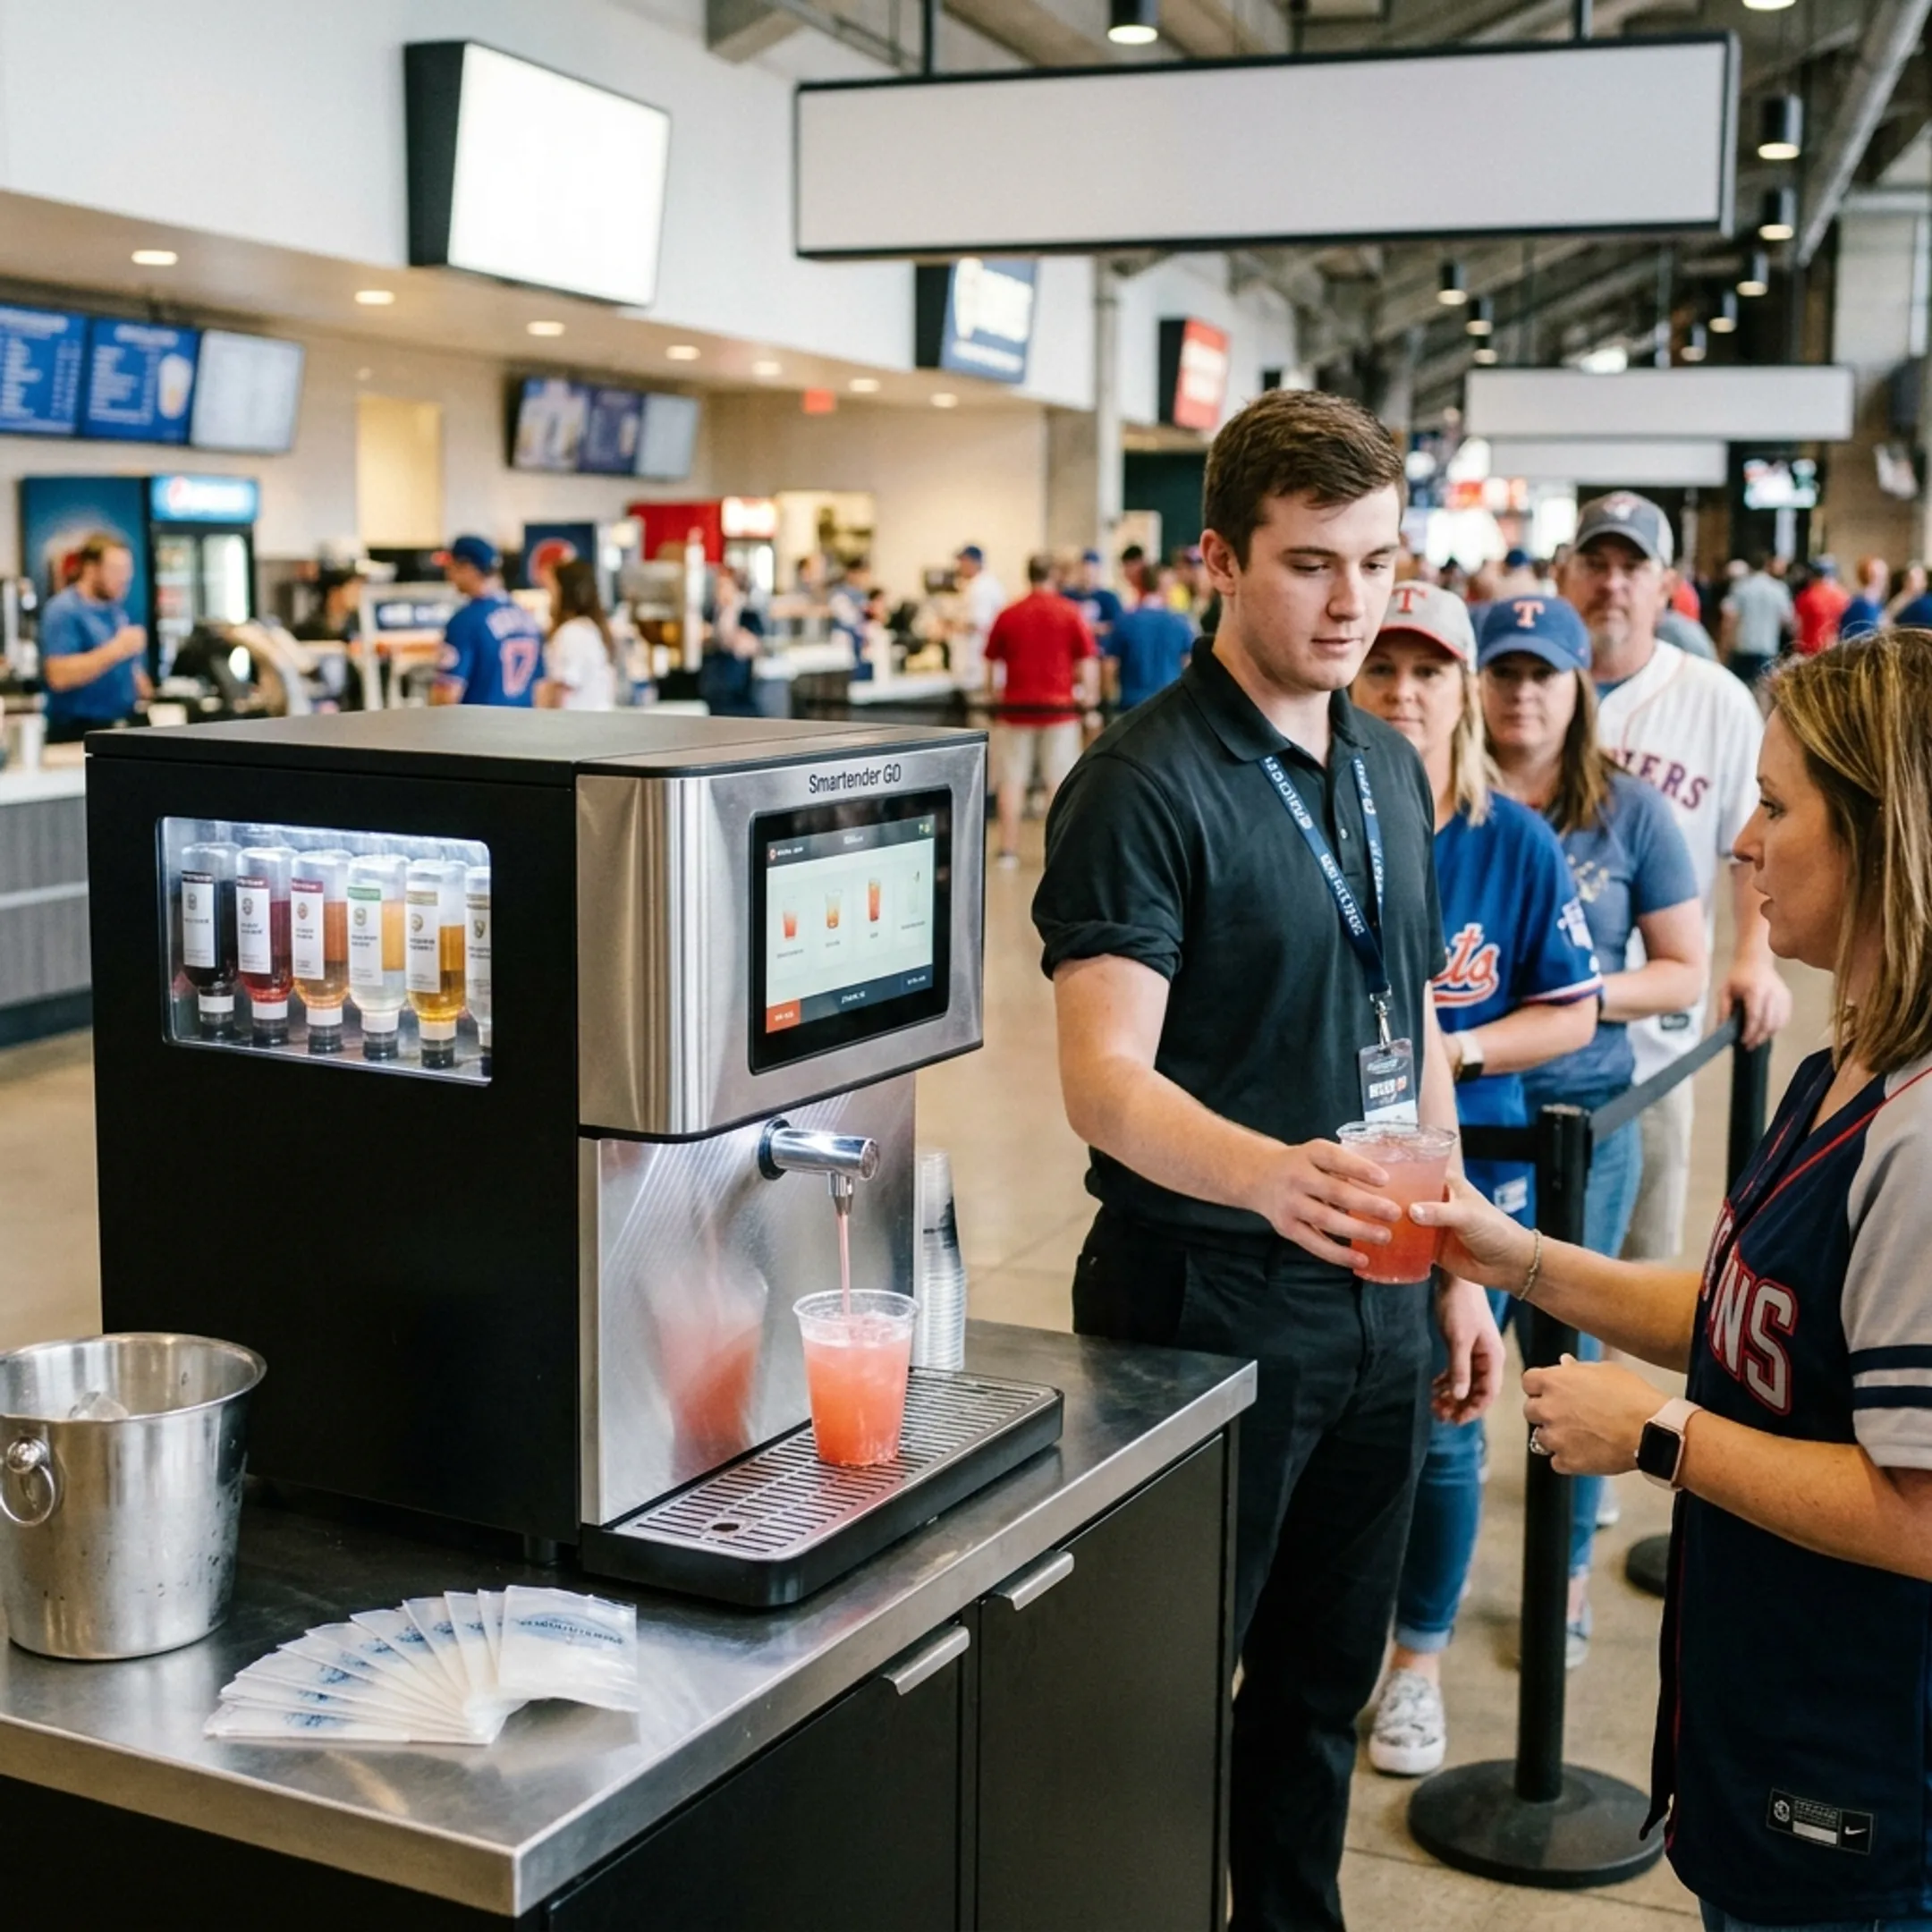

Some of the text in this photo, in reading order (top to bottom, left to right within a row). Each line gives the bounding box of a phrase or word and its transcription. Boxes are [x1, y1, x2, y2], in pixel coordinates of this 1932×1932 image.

[1513, 600, 1545, 628] T
[809, 763, 902, 794] Smartender GO
[1613, 750, 1710, 811] ERS
